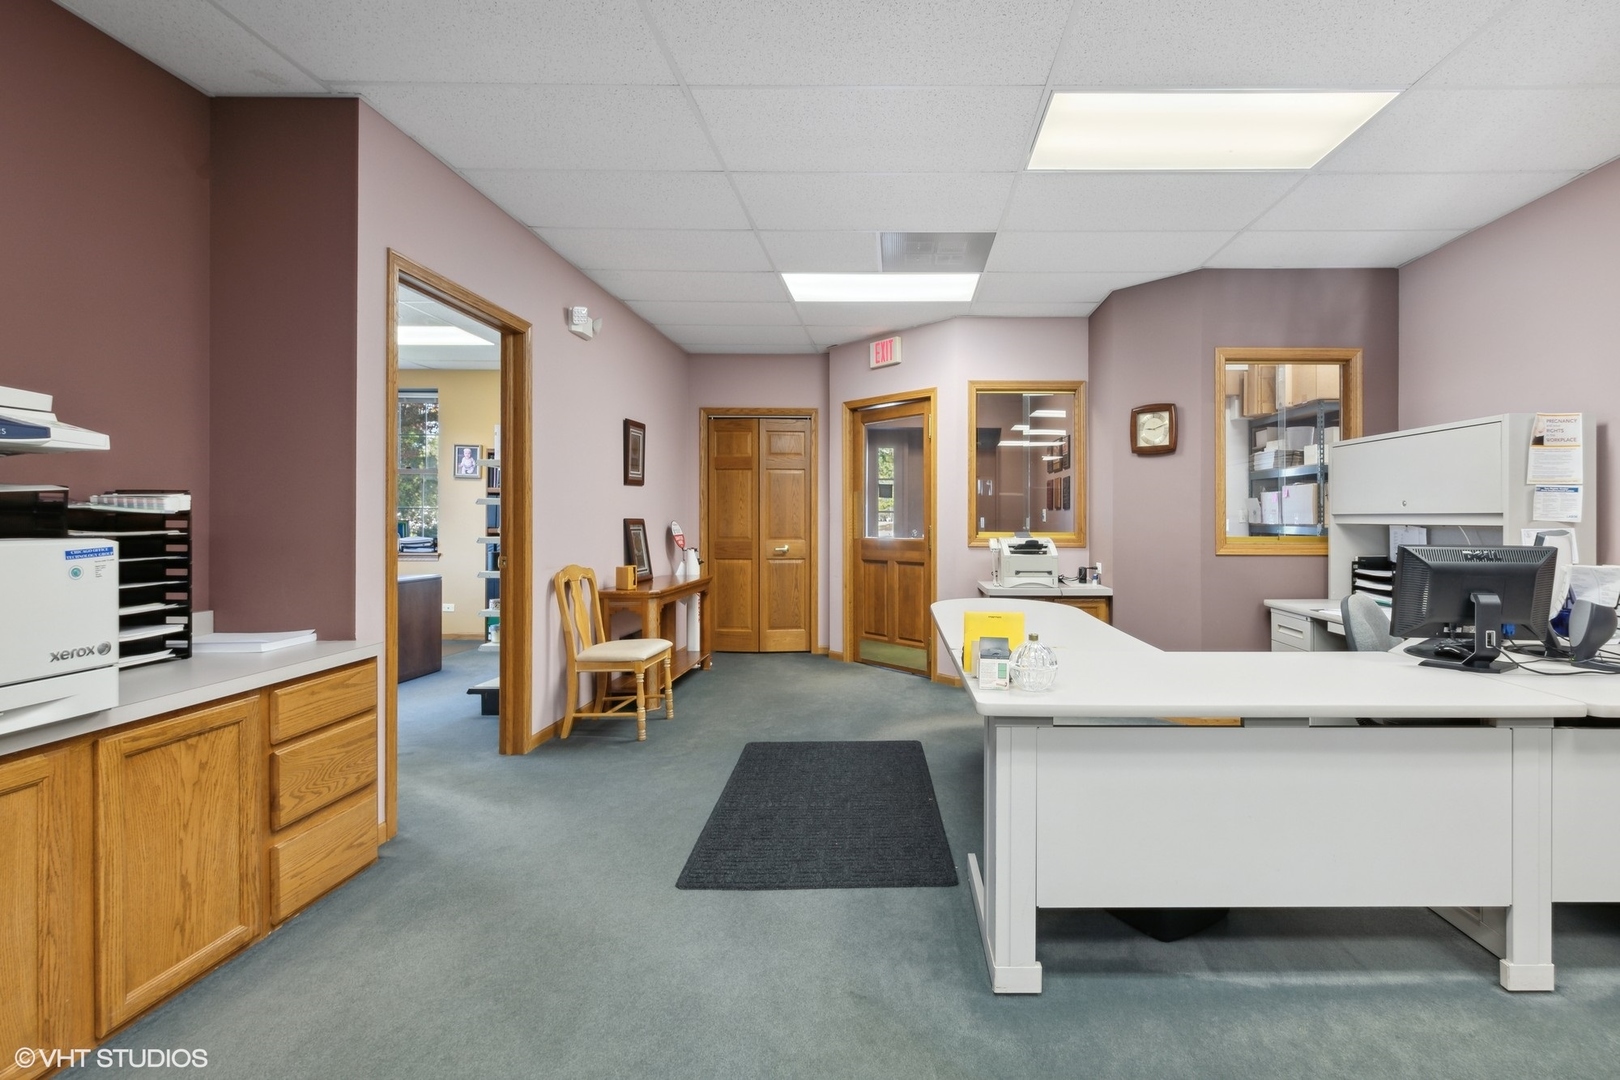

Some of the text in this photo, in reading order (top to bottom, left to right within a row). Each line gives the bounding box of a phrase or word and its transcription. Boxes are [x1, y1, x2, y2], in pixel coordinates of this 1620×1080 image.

[875, 339, 893, 364] EXIT
[1462, 550, 1502, 561] DELL
[50, 645, 95, 663] xerox
